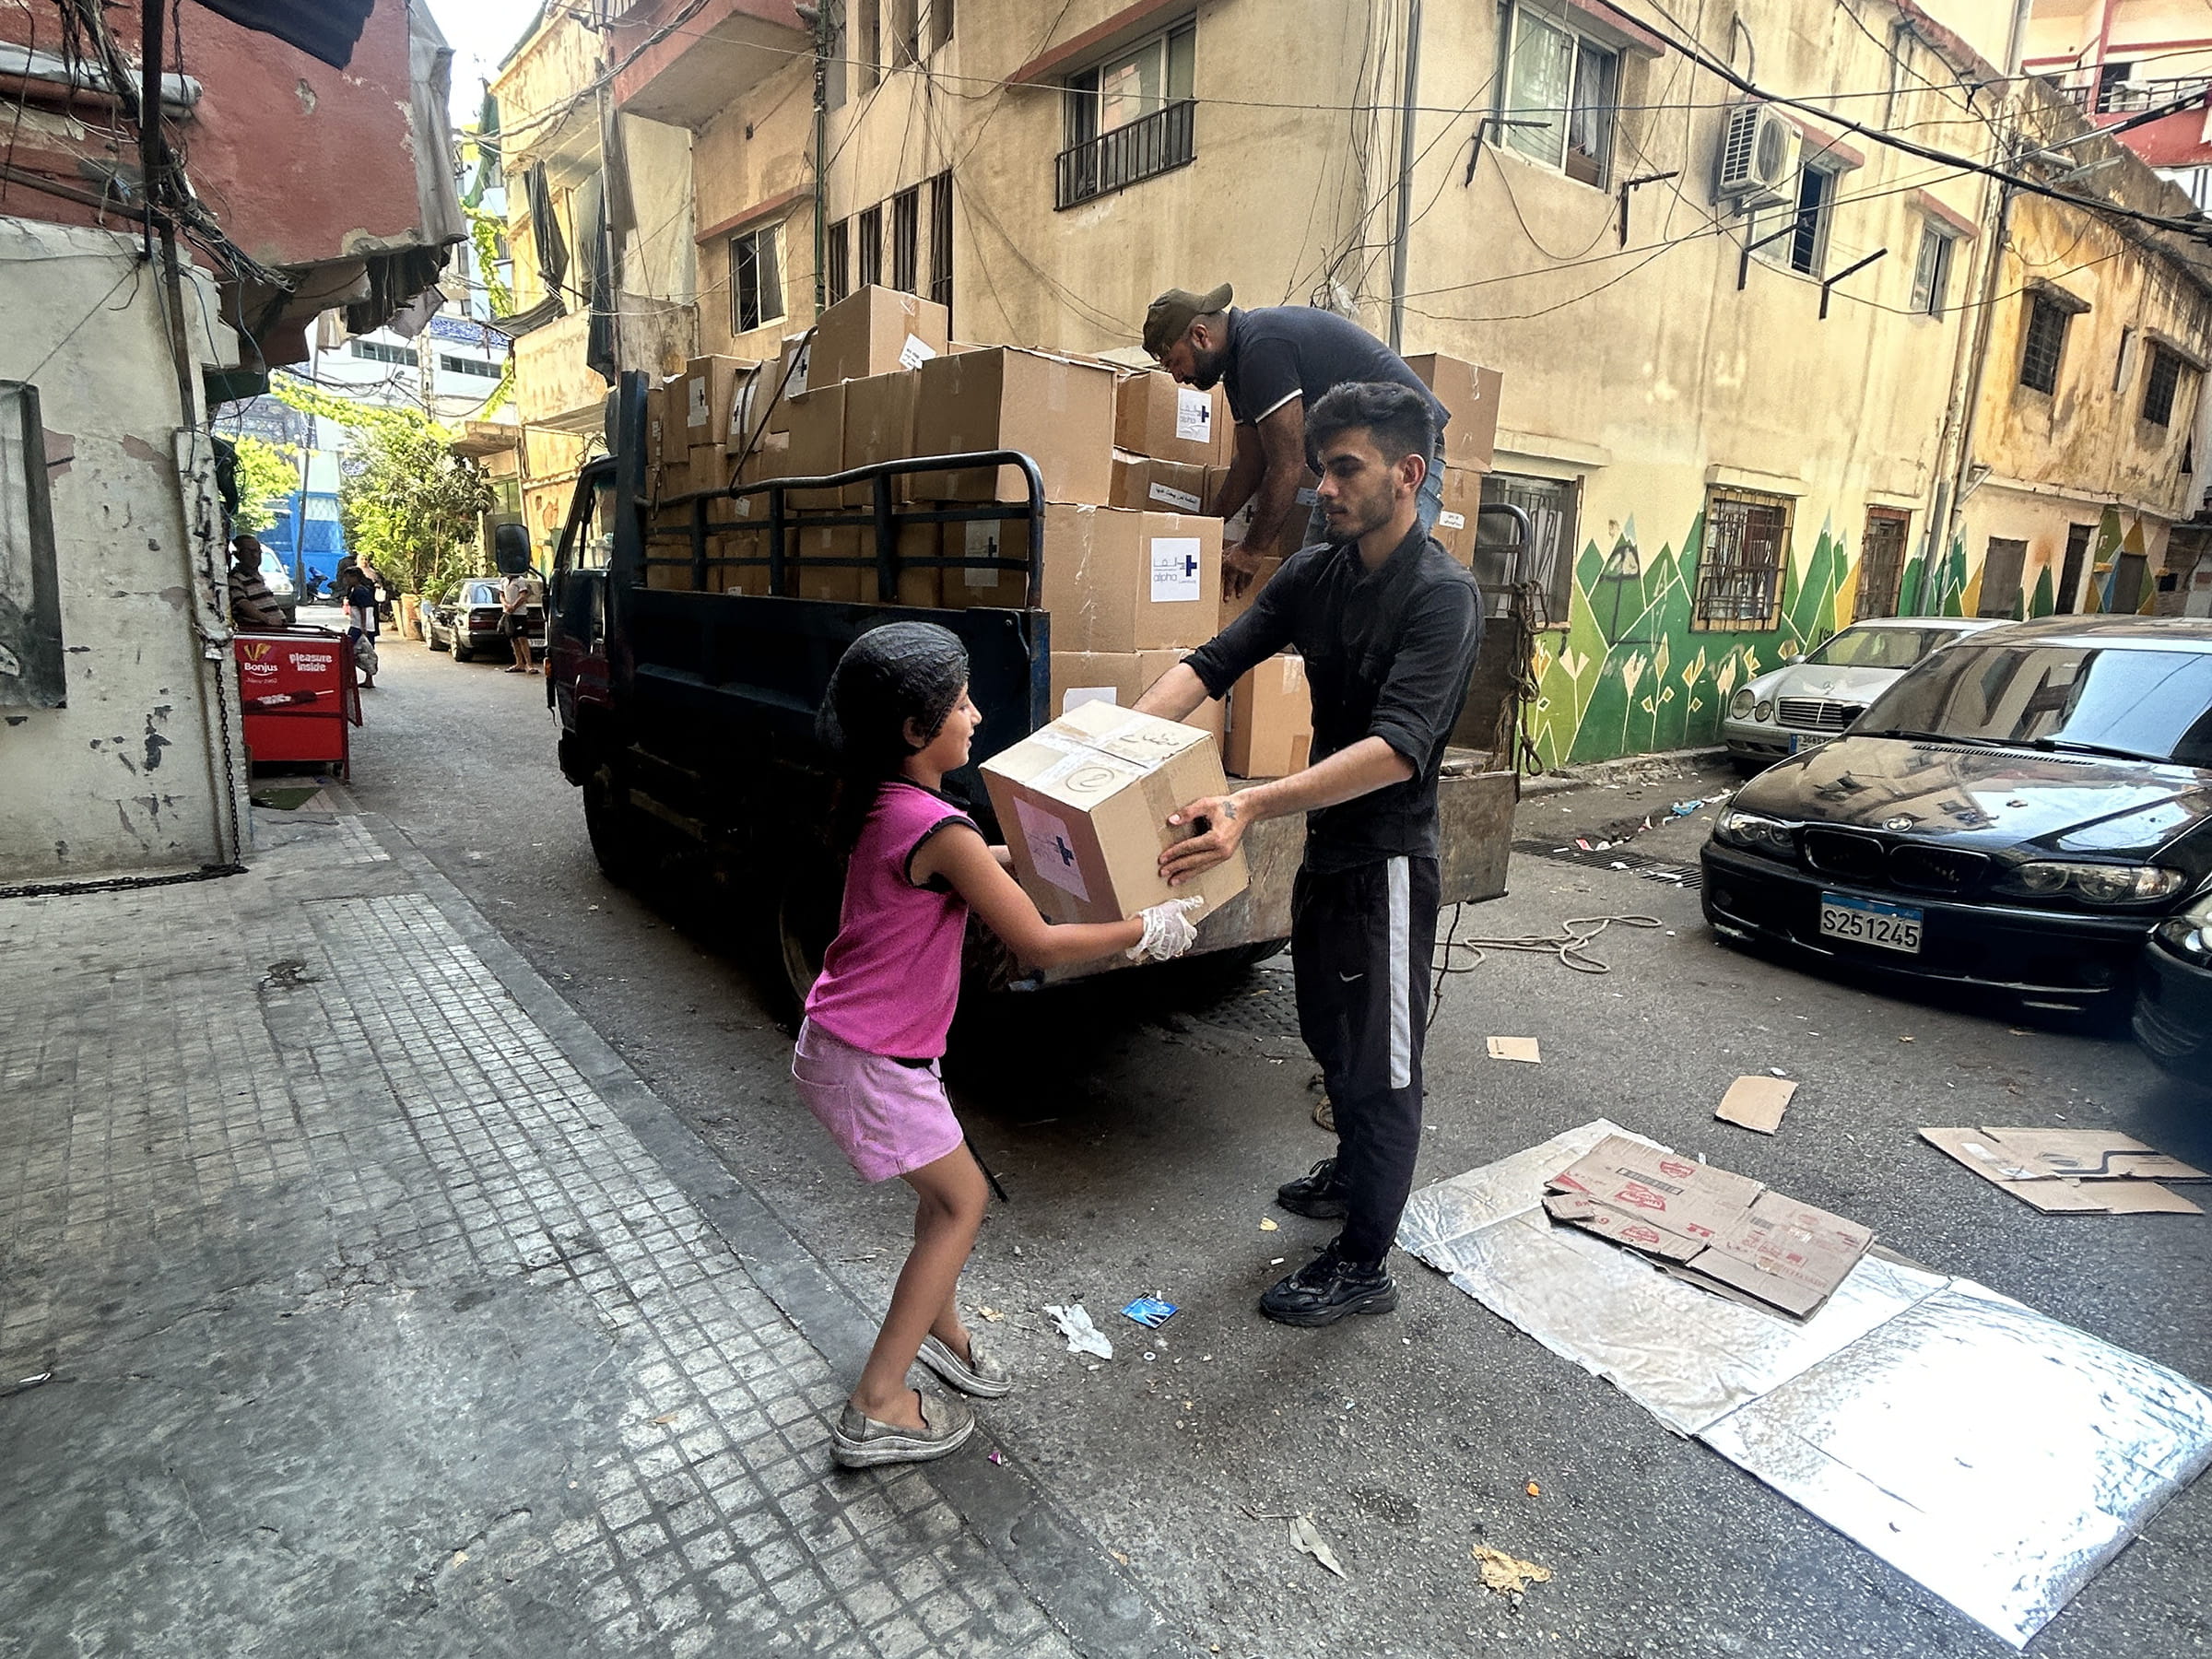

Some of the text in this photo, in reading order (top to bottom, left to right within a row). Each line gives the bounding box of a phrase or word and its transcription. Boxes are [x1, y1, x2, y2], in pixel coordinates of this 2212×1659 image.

[1153, 572, 1177, 582] alpha
[289, 653, 332, 664] pleasure
[244, 662, 277, 673] Bonjus
[297, 663, 326, 671] inside
[1823, 910, 1919, 947] S251245
